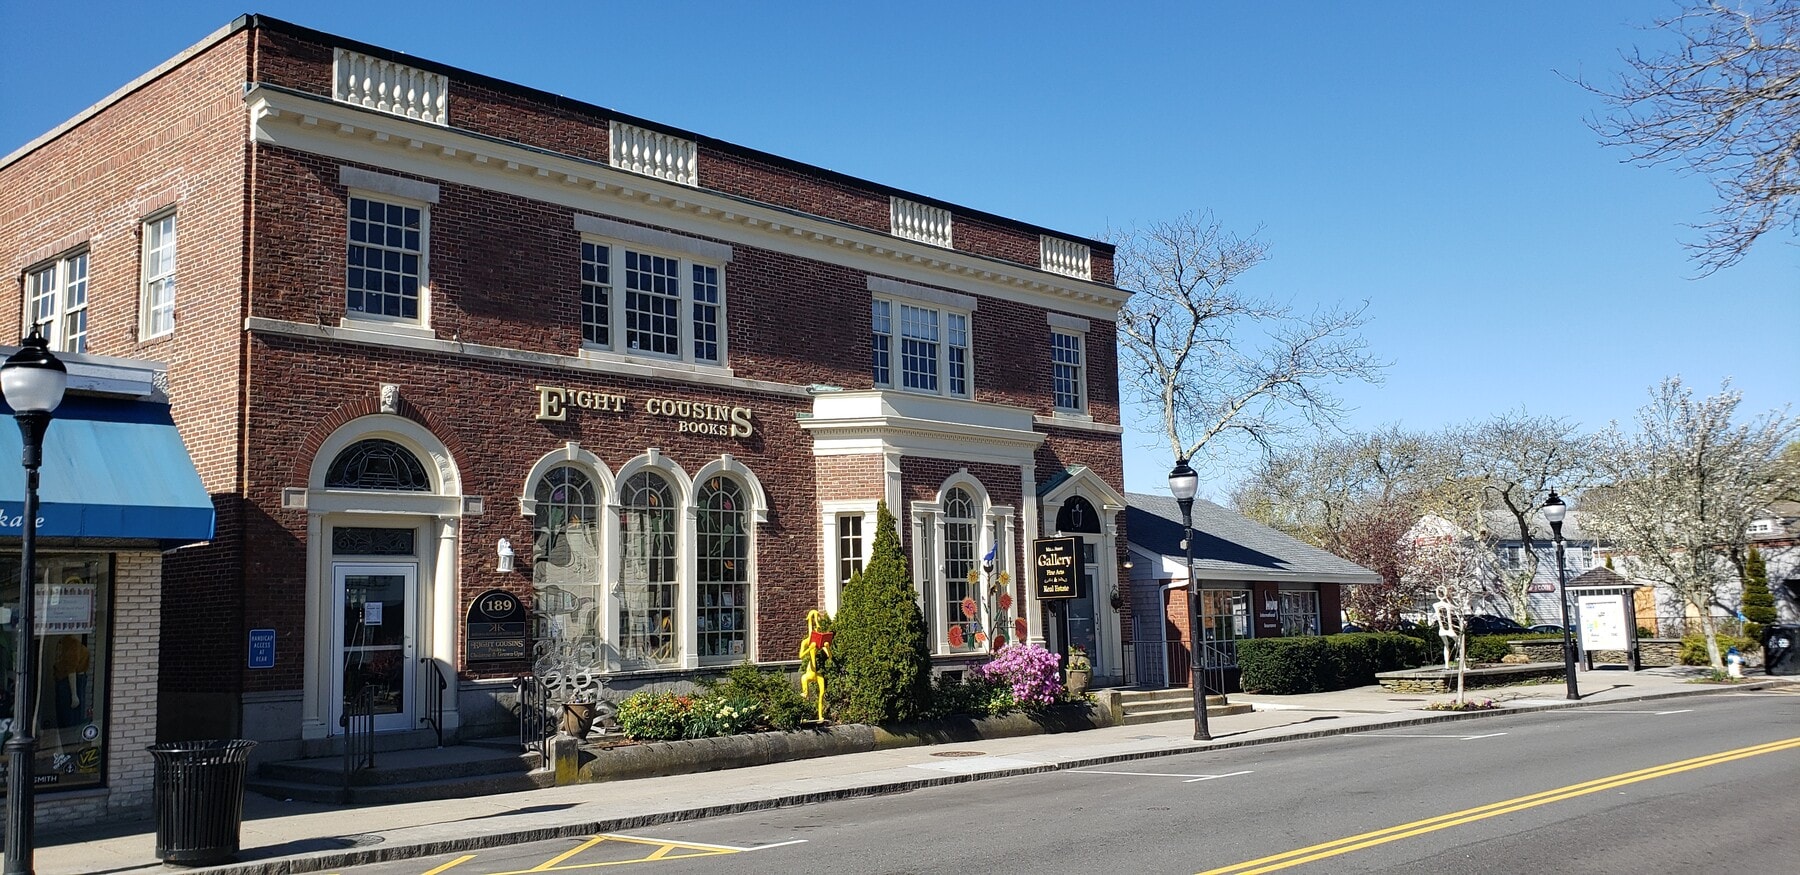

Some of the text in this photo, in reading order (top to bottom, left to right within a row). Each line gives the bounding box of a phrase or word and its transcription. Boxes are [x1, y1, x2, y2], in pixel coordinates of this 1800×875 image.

[535, 385, 753, 438] EIGHT COUSINS
[679, 421, 728, 436] BOOKS
[1038, 553, 1072, 568] Gallery
[1054, 584, 1069, 592] Estate
[486, 599, 512, 611] 189
